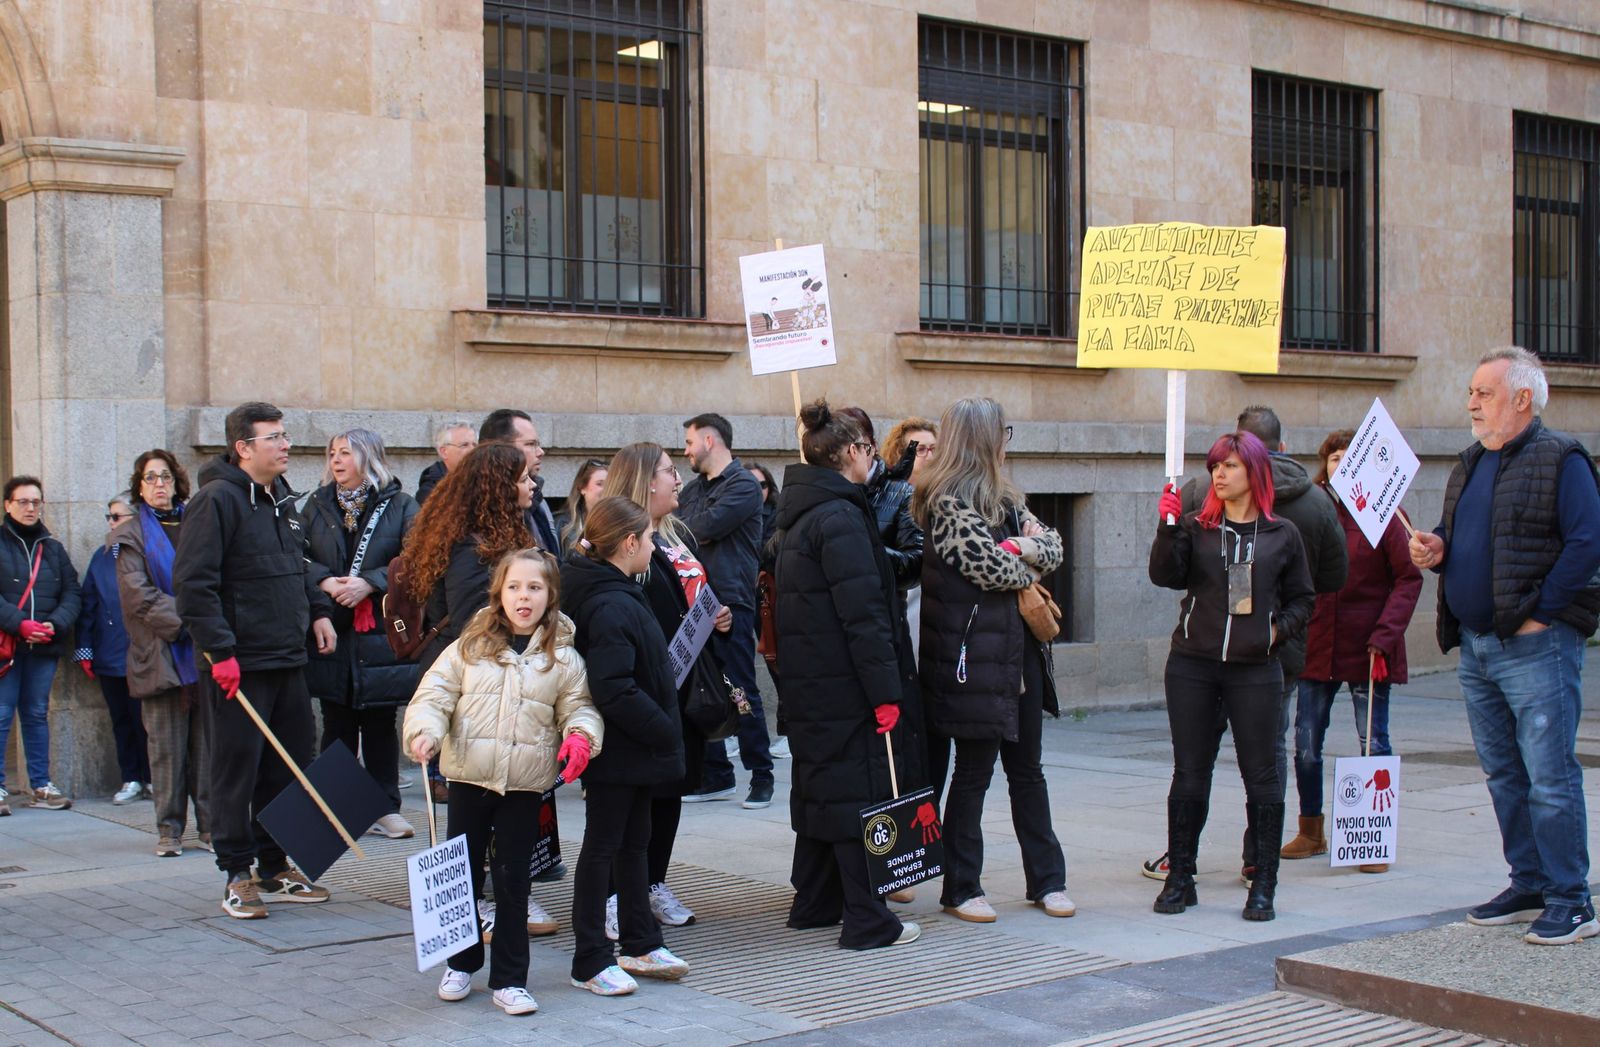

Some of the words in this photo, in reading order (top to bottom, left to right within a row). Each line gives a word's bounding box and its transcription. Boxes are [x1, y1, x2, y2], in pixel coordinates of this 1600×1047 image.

[759, 271, 797, 282] MANIFESTACIÓN
[798, 269, 808, 278] 30N
[1089, 255, 1195, 291] ADEMÁS
[1200, 264, 1240, 291] DE
[1086, 292, 1163, 319] PUTAS
[1174, 296, 1280, 328] PONEMOS
[752, 333, 787, 344] Sembrando
[788, 331, 808, 340] futuro
[1084, 327, 1113, 352] LA
[1124, 324, 1195, 352] CAMA
[1340, 466, 1348, 478] Si
[1346, 456, 1352, 466] el
[1352, 415, 1377, 459] autónomo
[1350, 431, 1379, 480] desaparece
[1377, 446, 1388, 462] 30
[1371, 476, 1393, 513] España
[1392, 465, 1400, 476] se
[1378, 474, 1407, 524] desvanece
[700, 588, 716, 617] TRABAJO
[690, 604, 703, 625] PARA
[1345, 787, 1357, 798] 30
[876, 822, 883, 831] N
[1336, 816, 1364, 830] DIGNA
[1368, 816, 1392, 828] VIDA
[874, 829, 889, 846] 30
[1344, 830, 1382, 845] DIGNO,
[418, 840, 465, 873] IMPUESTOS
[886, 852, 914, 868] HUNDE
[916, 848, 926, 856] SE
[1338, 845, 1389, 860] TRABAJO
[432, 860, 466, 889] AHOGAN
[528, 860, 552, 878] COLORE
[892, 860, 923, 877] ESPAÑA
[928, 865, 941, 876] SIN
[424, 874, 431, 890] A
[878, 870, 926, 895] AUTÓNOMOS
[435, 880, 469, 906] CUANDO
[423, 898, 434, 914] TE
[439, 900, 471, 928] CRECER
[449, 926, 460, 945] SE
[462, 920, 474, 939] NO
[420, 932, 448, 958] PUEDE
